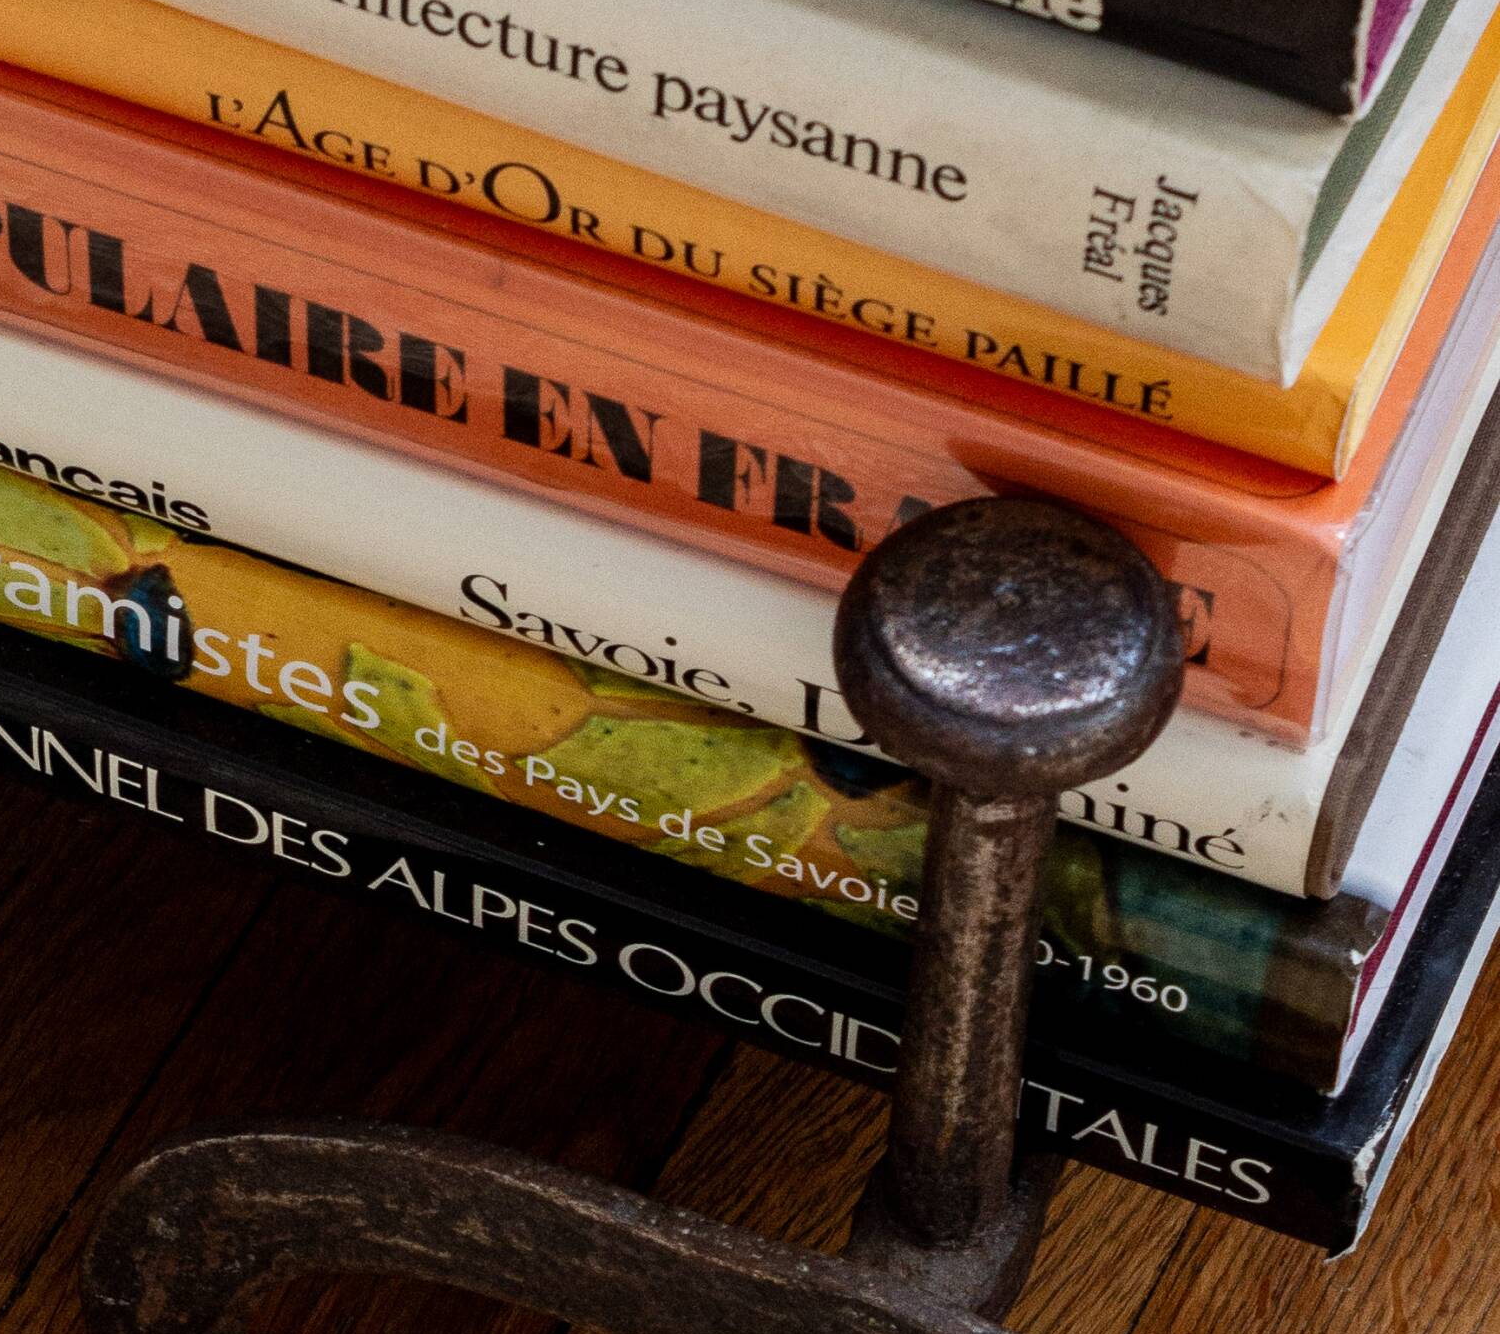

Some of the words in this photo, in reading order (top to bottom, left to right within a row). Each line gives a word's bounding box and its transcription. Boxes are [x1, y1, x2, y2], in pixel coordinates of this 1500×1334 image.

[651, 71, 969, 203] paysanne
[1082, 185, 1137, 283] Fréal
[1133, 174, 1200, 316] Jacques
[629, 223, 724, 281] DU
[748, 258, 938, 348] SIÈGE
[961, 328, 1176, 423] PAILLÉ
[501, 363, 666, 486] EN
[459, 573, 756, 714] Savoie,
[414, 721, 507, 777] des
[524, 755, 641, 824] Pays
[658, 807, 726, 854] de
[743, 833, 920, 923] Savoie
[204, 787, 352, 879] DES
[368, 855, 599, 967] ALPES
[618, 941, 1275, 1207] OCCIDTALES
